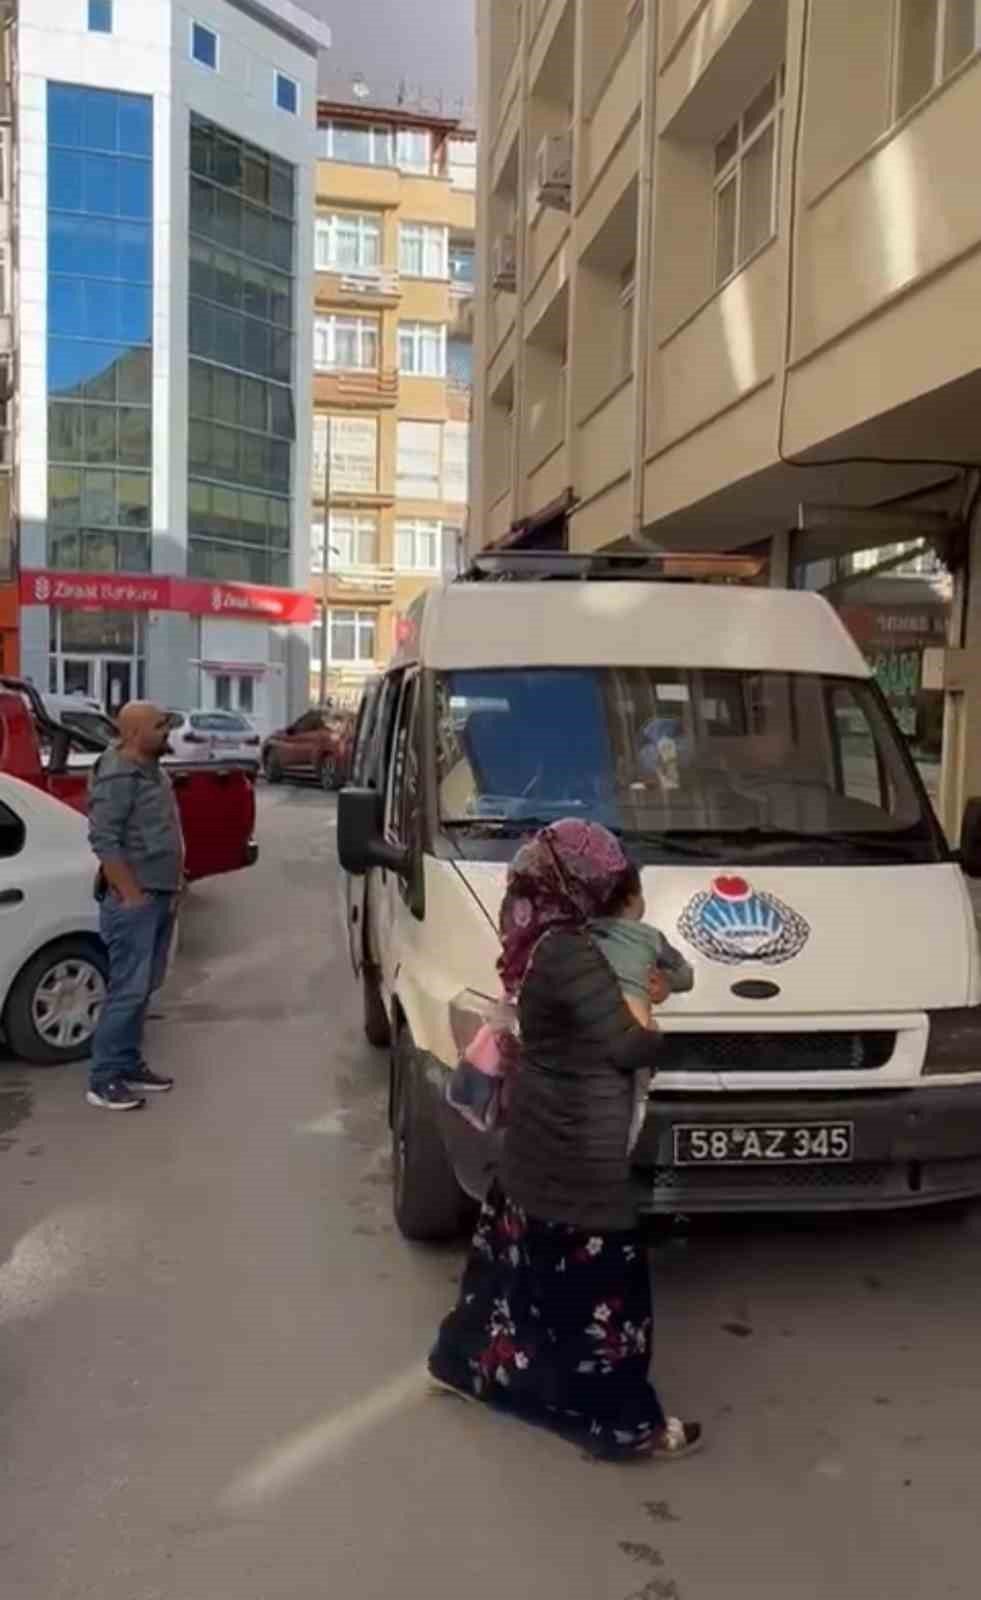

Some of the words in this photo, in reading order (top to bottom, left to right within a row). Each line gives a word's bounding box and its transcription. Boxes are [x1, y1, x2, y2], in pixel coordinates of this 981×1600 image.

[690, 1130, 728, 1159] 58
[741, 1130, 786, 1158] AZ
[793, 1128, 848, 1157] 345
